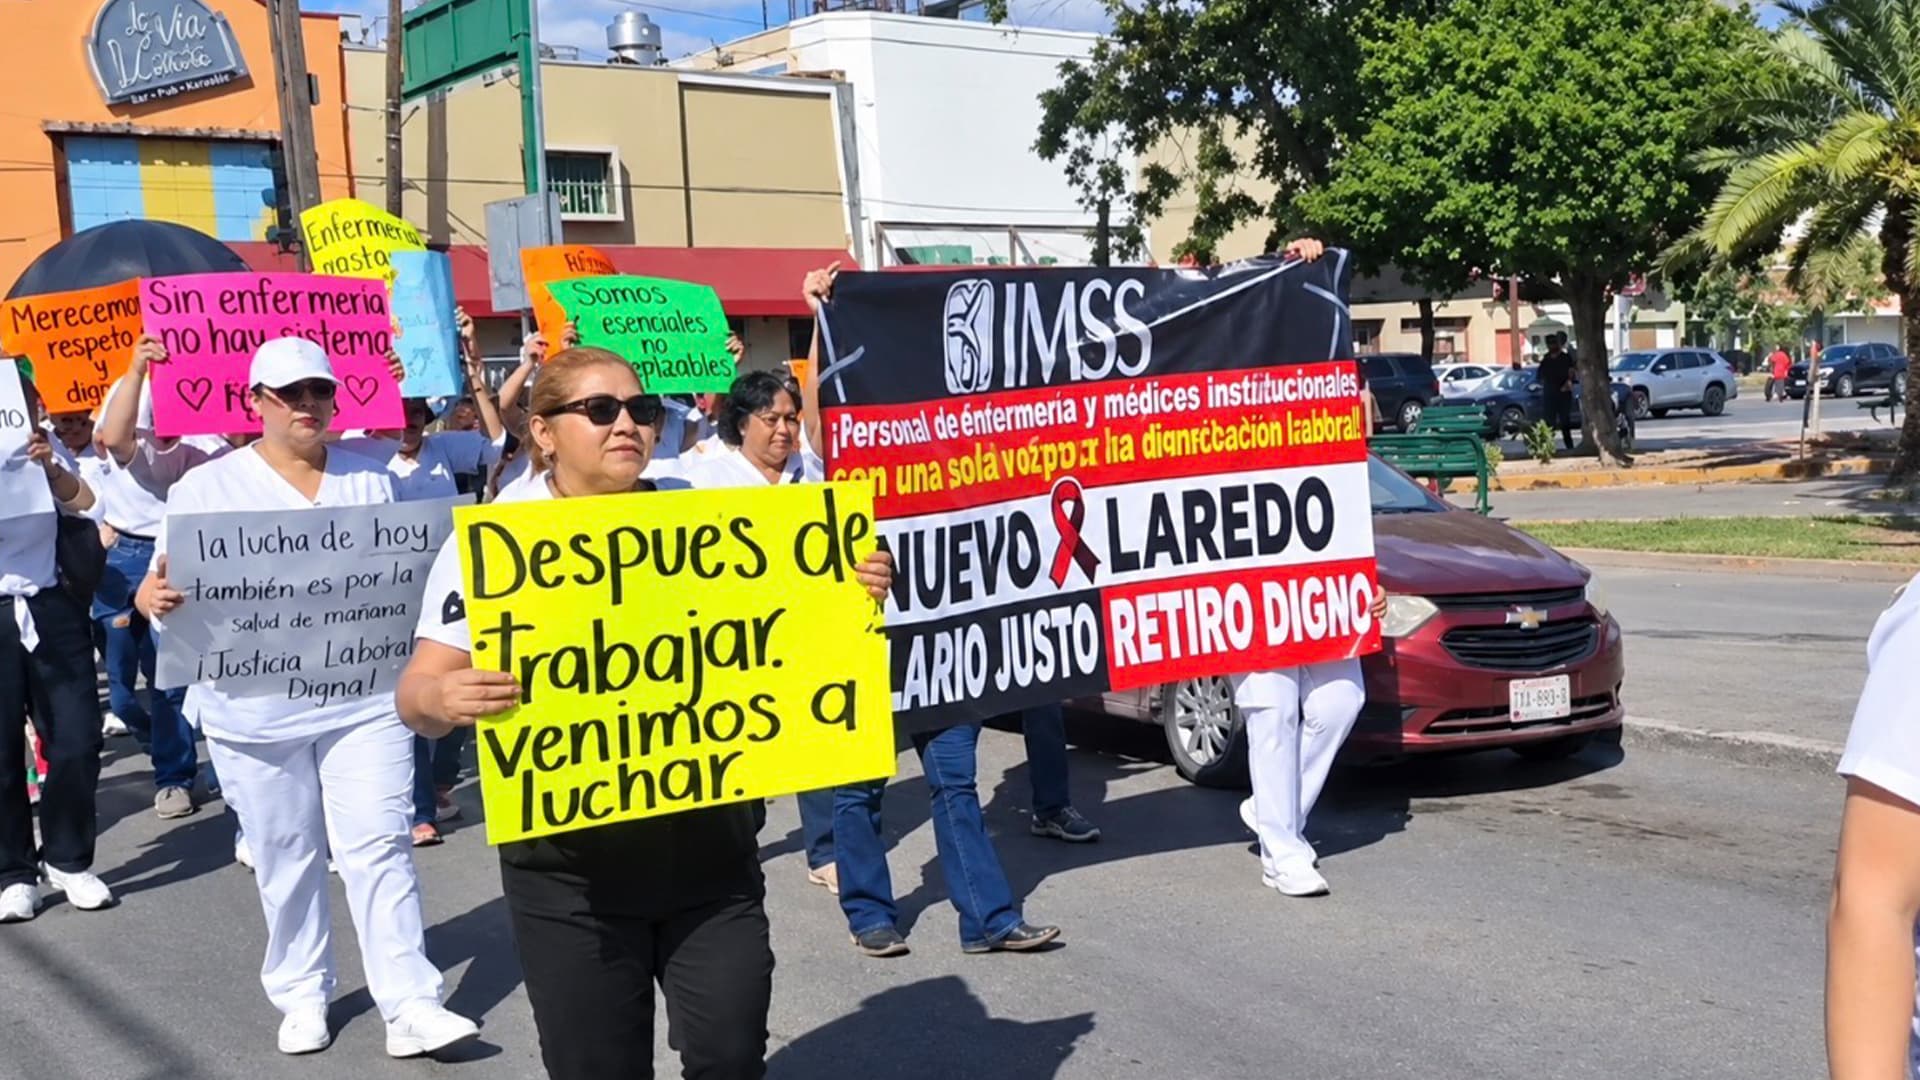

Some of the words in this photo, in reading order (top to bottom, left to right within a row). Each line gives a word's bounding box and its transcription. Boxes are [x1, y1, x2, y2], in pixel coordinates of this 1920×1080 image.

[155, 4, 207, 46] Via
[157, 85, 179, 99] Pub
[149, 280, 205, 316] Sin
[572, 281, 668, 308] Somos
[47, 325, 134, 361] respeto
[160, 327, 200, 355] no
[602, 310, 709, 336] esenciales
[1003, 278, 1153, 388] IMSS
[641, 337, 668, 355] no
[94, 358, 109, 382] y
[934, 408, 960, 441] de
[1085, 395, 1098, 429] y
[895, 462, 941, 496] una
[198, 529, 229, 562] la
[238, 520, 310, 557] lucha
[320, 520, 355, 552] de
[373, 517, 429, 552] hoy
[794, 488, 869, 583] de
[876, 510, 1041, 613] NUEVO
[1106, 476, 1335, 575] LAREDO
[190, 575, 295, 602] también
[307, 577, 333, 596] es
[344, 570, 383, 598] por
[391, 561, 413, 586] la
[231, 611, 280, 634] salud
[289, 611, 313, 629] de
[323, 602, 407, 626] mañana
[994, 602, 1099, 692] JUSTO
[1109, 582, 1253, 668] RETIRO
[1263, 572, 1373, 644] DIGNO
[324, 629, 415, 669] Laboral
[288, 667, 377, 708] Digna!
[811, 679, 857, 731] a
[484, 692, 782, 779] venimos
[521, 750, 745, 833] luchar.
